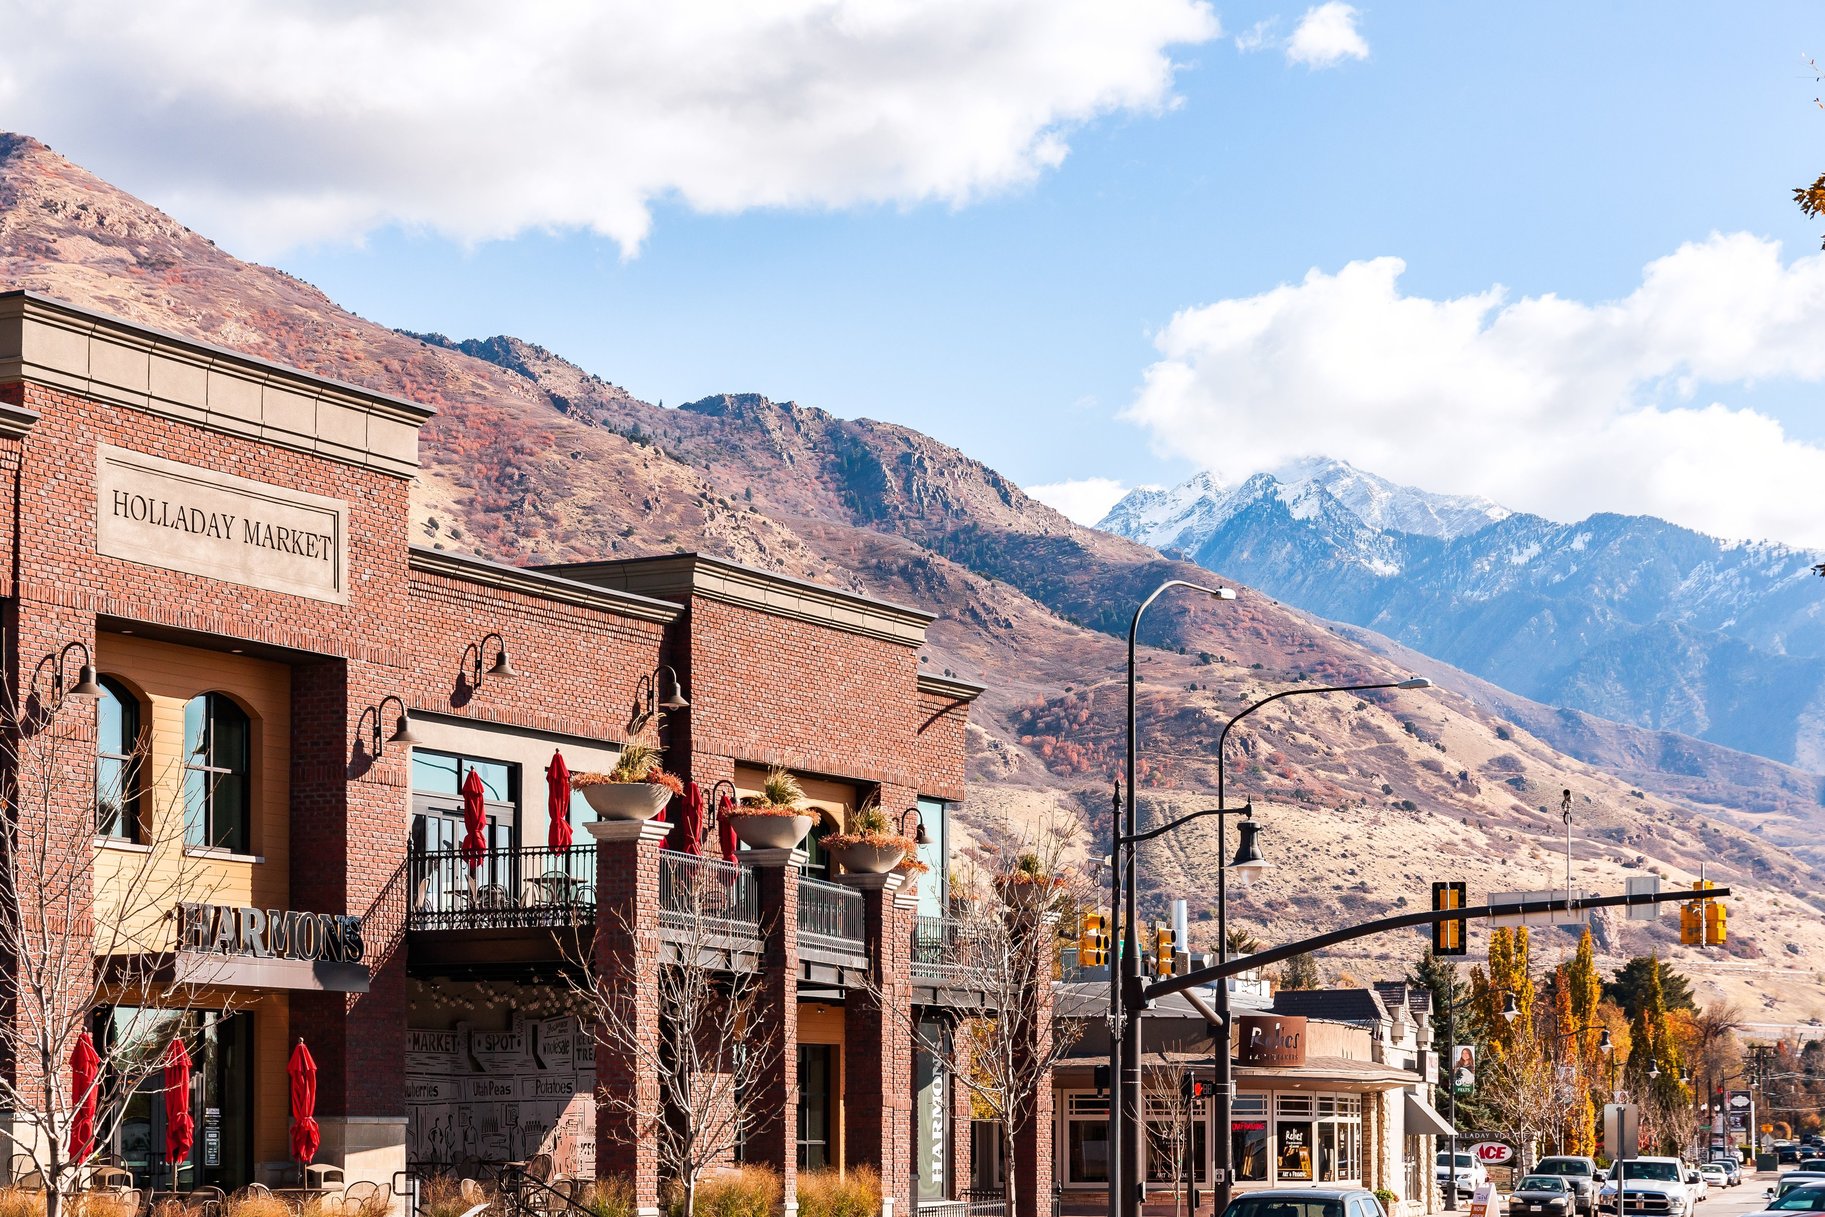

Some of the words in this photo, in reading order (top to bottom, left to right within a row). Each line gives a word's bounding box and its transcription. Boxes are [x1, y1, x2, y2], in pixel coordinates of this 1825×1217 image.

[112, 488, 236, 541] HOLLADAY
[243, 518, 332, 562] MARKET
[176, 901, 365, 963] HARMONS
[412, 1033, 458, 1052] MARKET
[485, 1033, 516, 1052] SPOT
[1250, 1022, 1300, 1050] Relics
[536, 1078, 574, 1096] Potatoes
[931, 1040, 944, 1184] HARMONS
[1476, 1144, 1507, 1160] ACE
